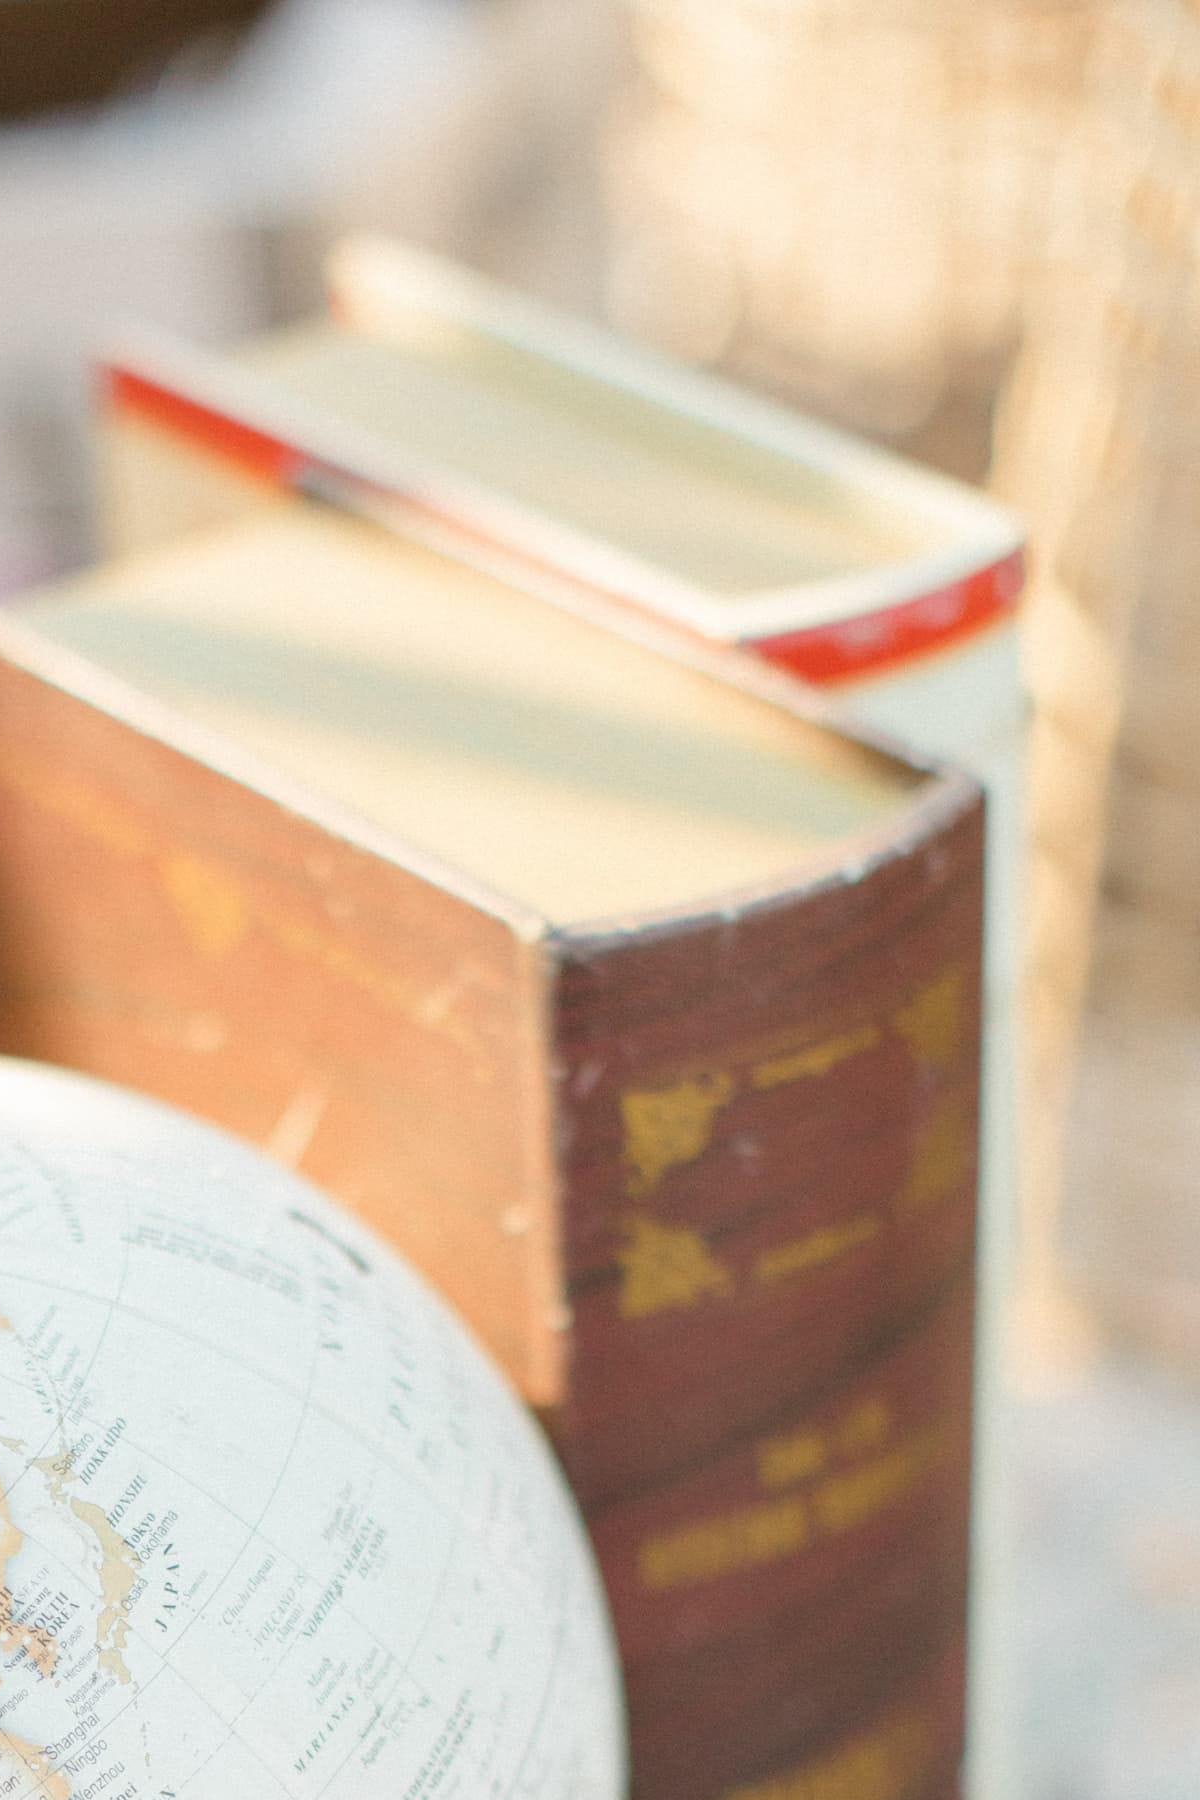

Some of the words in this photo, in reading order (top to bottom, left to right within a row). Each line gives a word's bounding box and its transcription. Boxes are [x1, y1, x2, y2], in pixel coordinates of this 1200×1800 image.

[123, 1512, 156, 1551] Tokyo
[37, 1603, 80, 1647] KOREA
[43, 1714, 101, 1760] Shanghai
[64, 1738, 108, 1776] Ningbo
